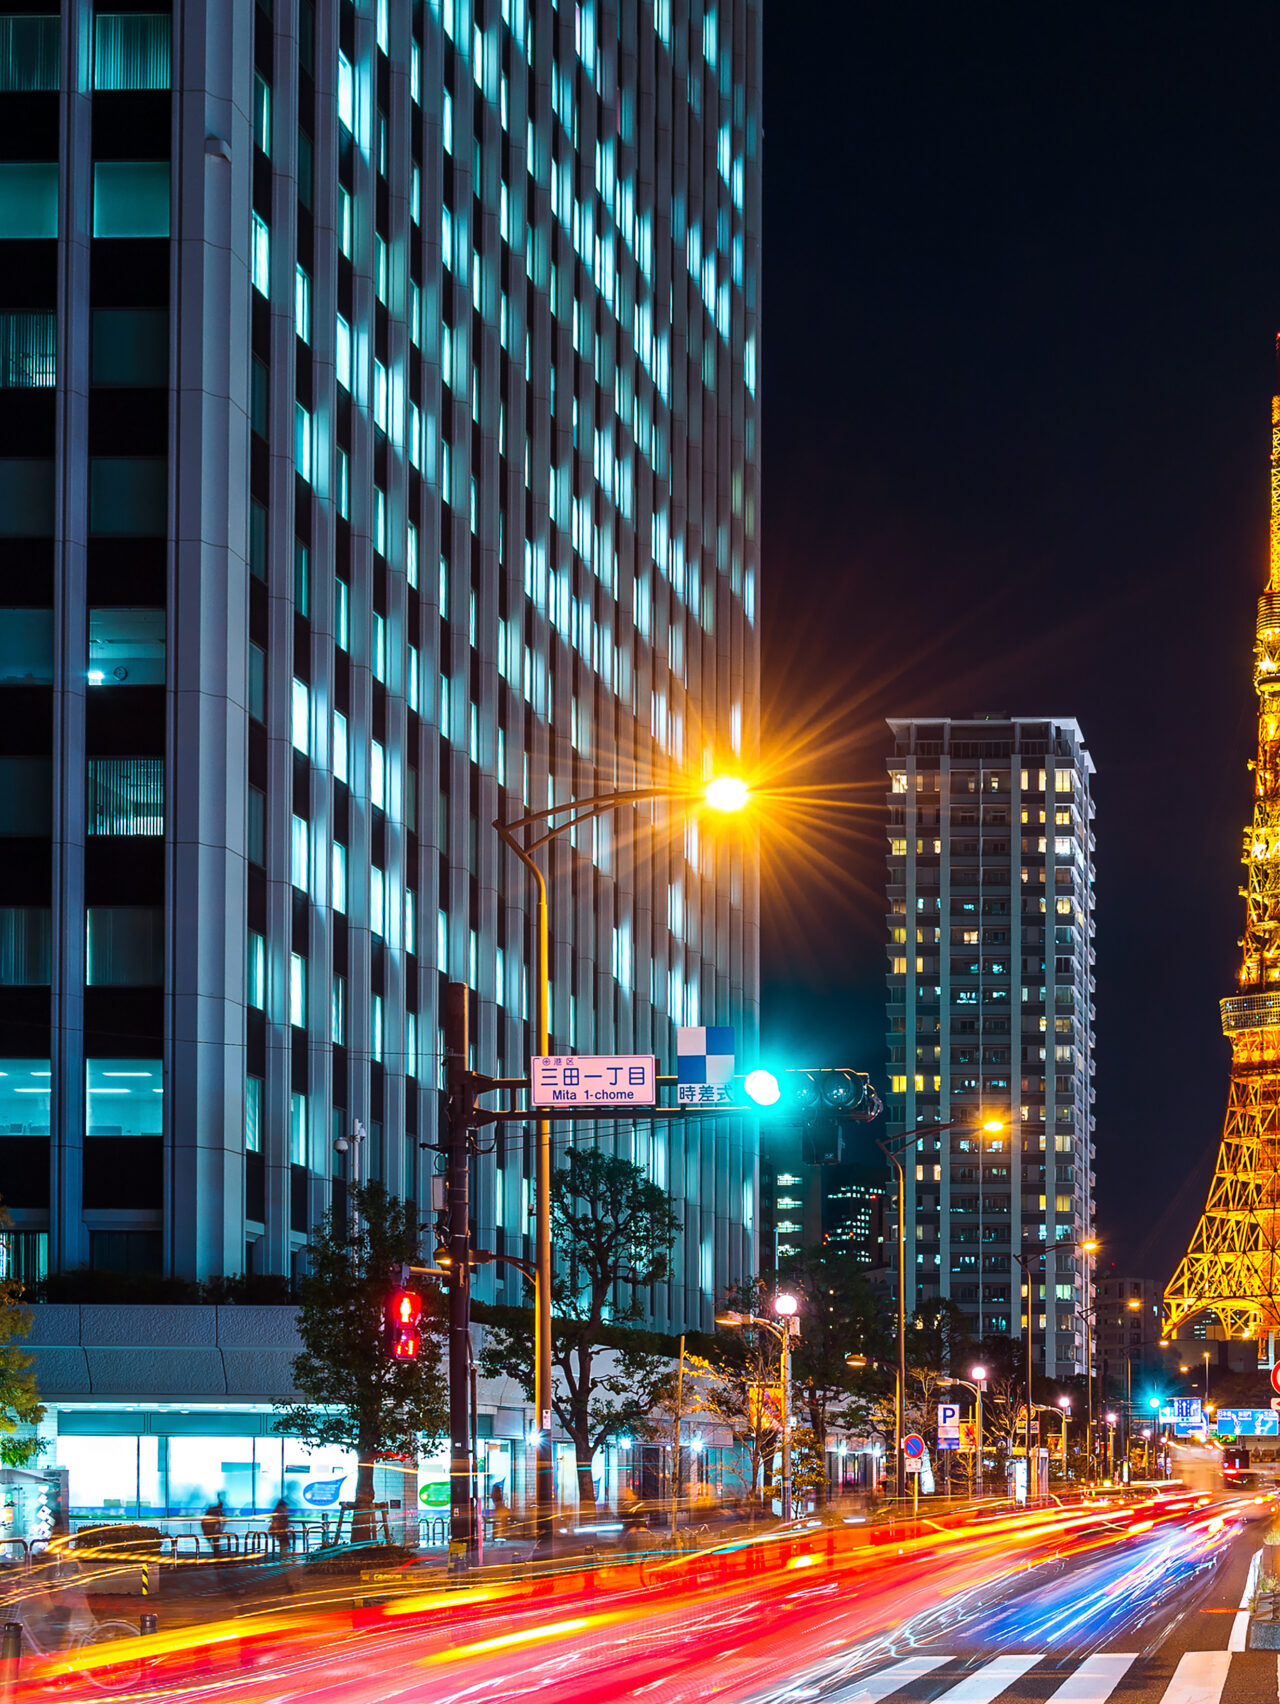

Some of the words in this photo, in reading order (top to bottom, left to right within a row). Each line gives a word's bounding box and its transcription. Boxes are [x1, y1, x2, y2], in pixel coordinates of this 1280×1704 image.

[540, 1066, 645, 1086] 三田一丁目
[552, 1089, 577, 1101] Mita
[584, 1089, 635, 1100] 1-chome
[679, 1085, 733, 1103] 時差式
[943, 1407, 956, 1424] P
